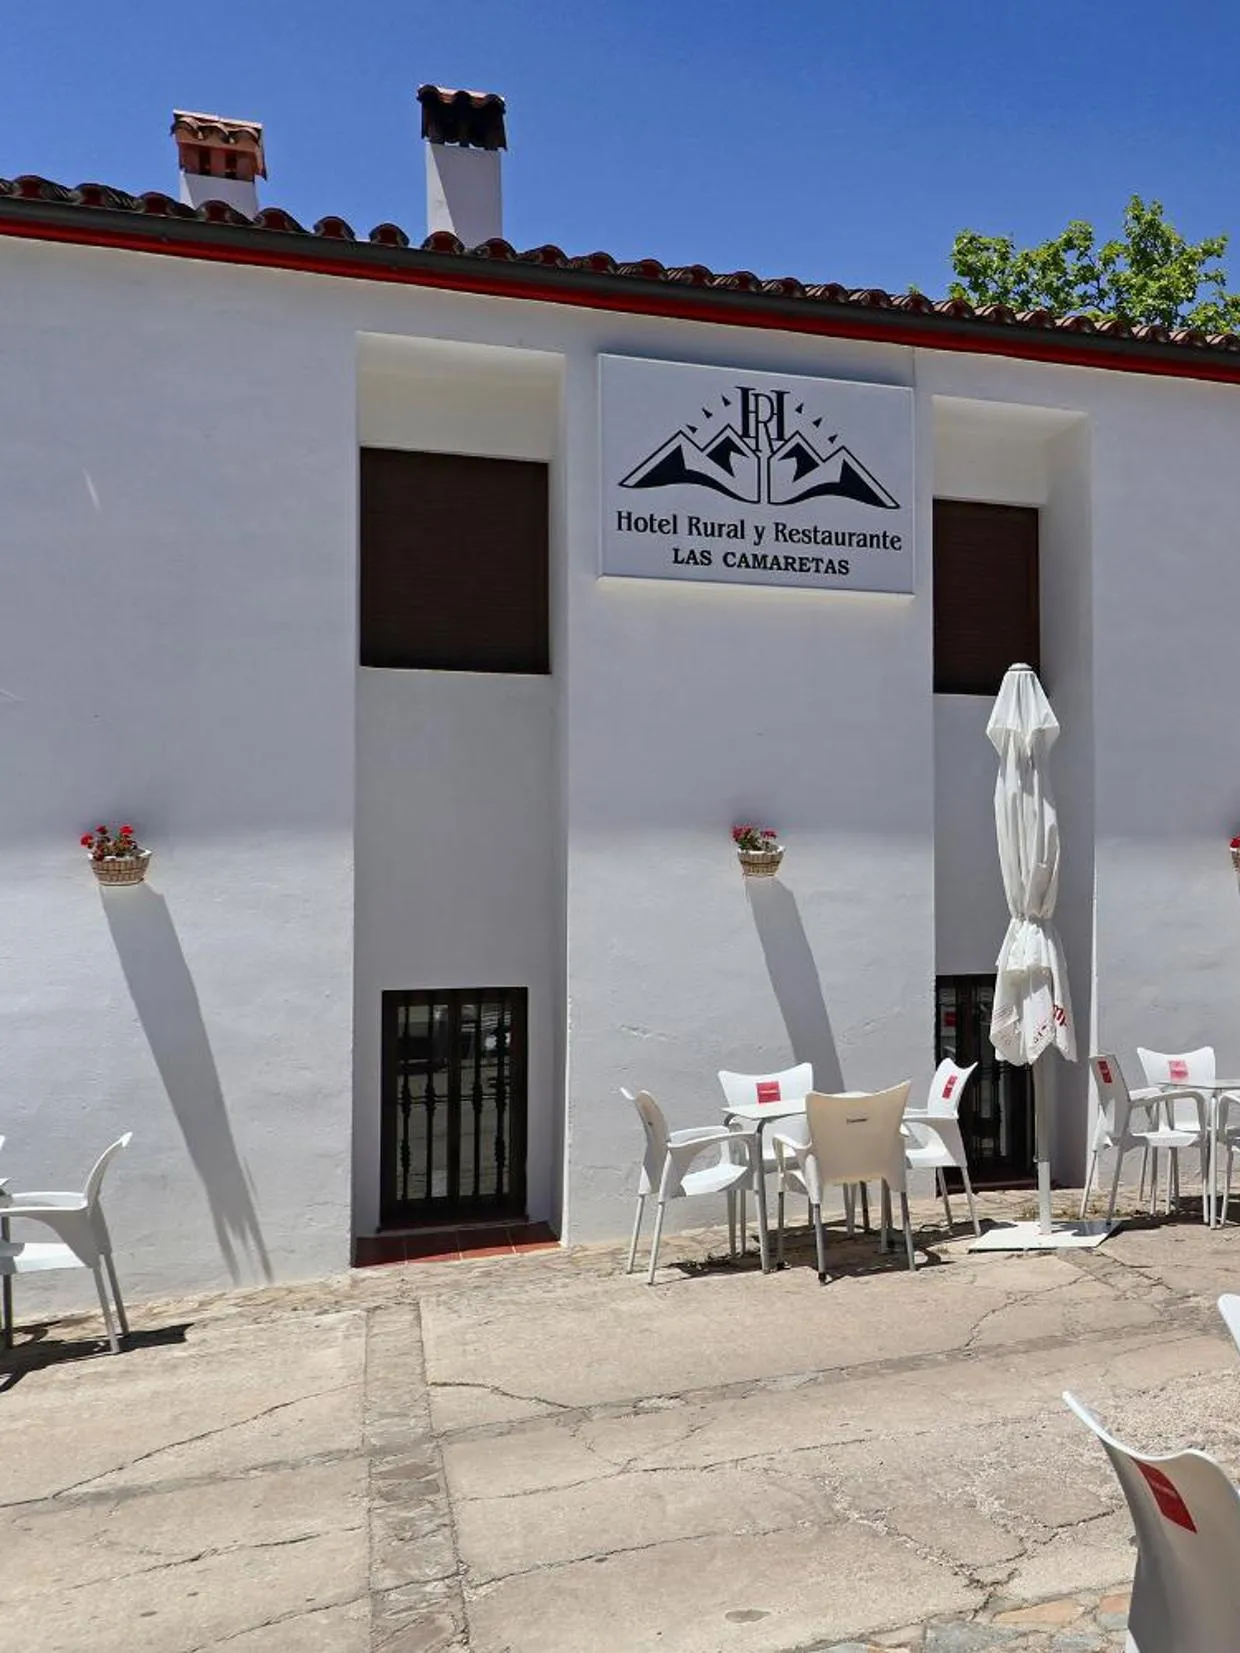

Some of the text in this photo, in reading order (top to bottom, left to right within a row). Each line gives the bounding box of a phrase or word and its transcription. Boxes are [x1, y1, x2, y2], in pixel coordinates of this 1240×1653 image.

[616, 510, 902, 551] Hotel Rural y Restaurante
[672, 547, 850, 576] LAS CAMARETAS
